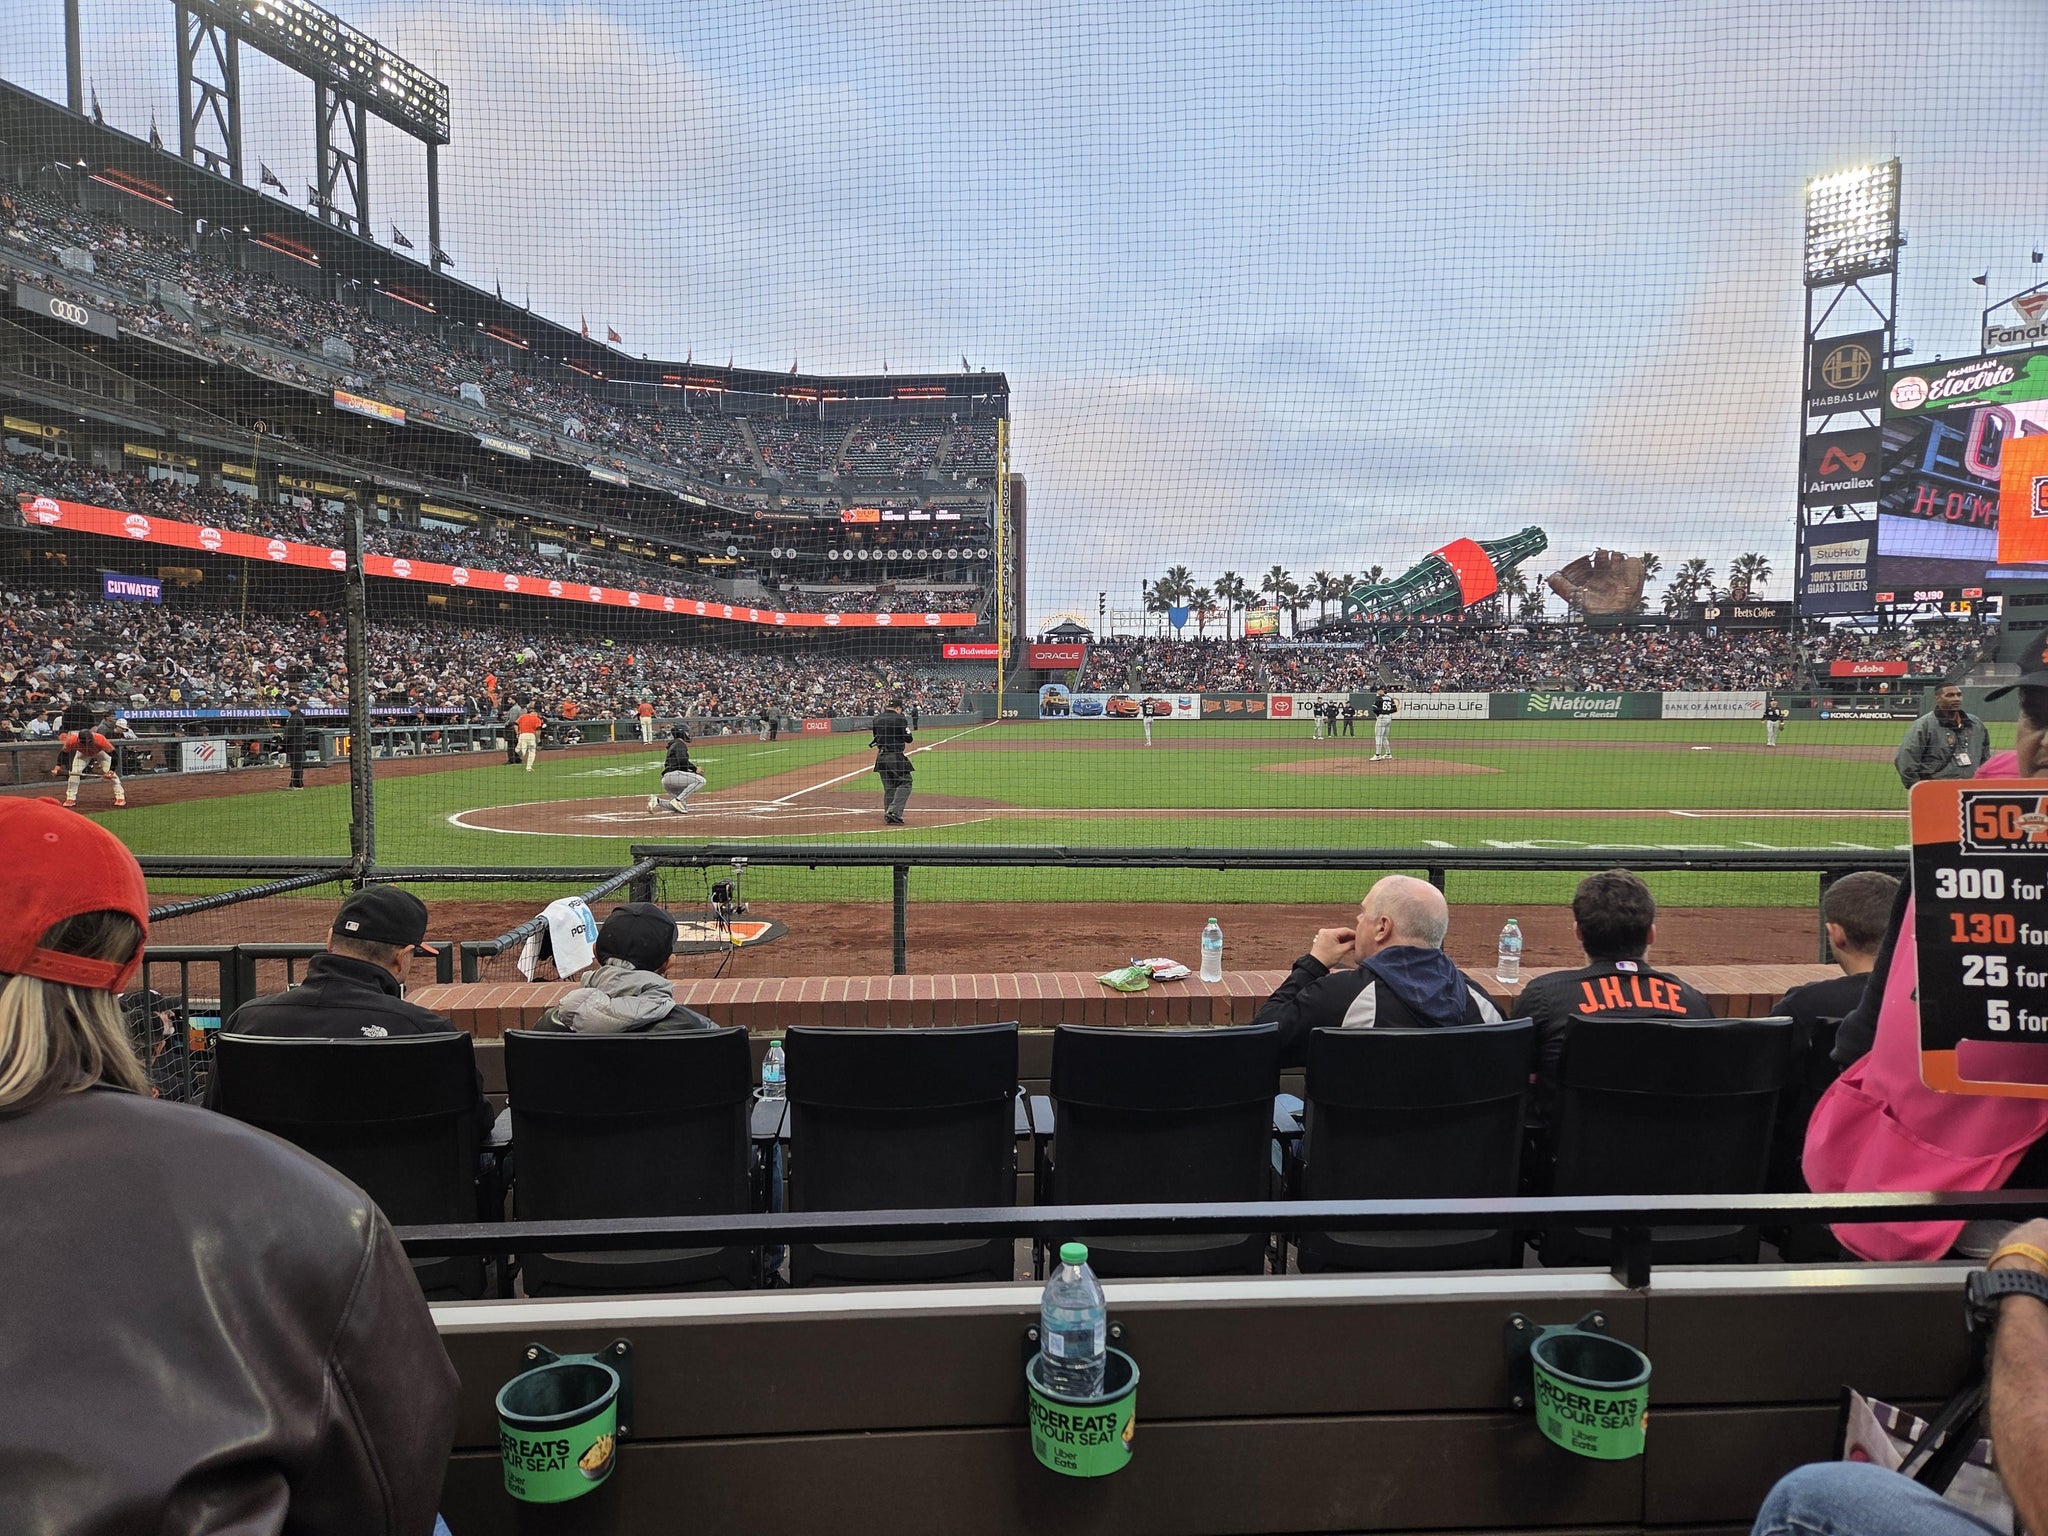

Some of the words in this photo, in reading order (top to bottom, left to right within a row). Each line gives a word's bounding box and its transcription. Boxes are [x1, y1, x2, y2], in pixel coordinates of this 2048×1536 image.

[1987, 323, 2048, 345] Fanat
[1946, 359, 1998, 378] McMILLAN
[1928, 365, 2015, 401] Electric
[1811, 394, 1854, 407] HABBAS
[1856, 389, 1880, 401] LAW
[1809, 478, 1874, 494] Airwallex
[1816, 549, 1860, 559] StubHub
[1810, 570, 1831, 582] 100%
[1832, 569, 1866, 580] VERIFIED
[107, 580, 160, 598] CUTWATER
[1807, 582, 1835, 594] GIANTS
[1836, 581, 1868, 593] TICKETS
[1753, 607, 1777, 618] Coffee
[1035, 652, 1079, 660] ORACLE
[1853, 665, 1884, 673] Adobe
[1382, 701, 1392, 711] 65
[1403, 701, 1456, 711] Hanwha
[1458, 701, 1483, 711] Life
[1549, 696, 1622, 710] National
[1703, 703, 1744, 711] AMERICA
[1002, 709, 1018, 717] 339
[806, 722, 828, 730] ORACLE
[1935, 868, 2004, 900] 300
[2011, 878, 2044, 900] for
[1950, 913, 2015, 944] 130
[1962, 955, 2009, 987] 25
[2014, 965, 2048, 988] for
[1630, 974, 1688, 1015] LEE
[1987, 1000, 2011, 1031] 5
[1552, 1399, 1597, 1428] YOUR
[1600, 1414, 1637, 1429] SEAT
[1594, 1398, 1638, 1416] EATS
[1072, 1412, 1117, 1432] EATS
[1038, 1418, 1076, 1445] YOUR
[1079, 1428, 1116, 1446] SEAT
[520, 1439, 570, 1458] EATS
[1571, 1437, 1598, 1452] Eats
[1054, 1446, 1078, 1460] Uber
[526, 1455, 570, 1472] SEAT
[1054, 1456, 1078, 1470] Eats
[507, 1471, 526, 1486] Uber
[508, 1479, 527, 1496] Eats
